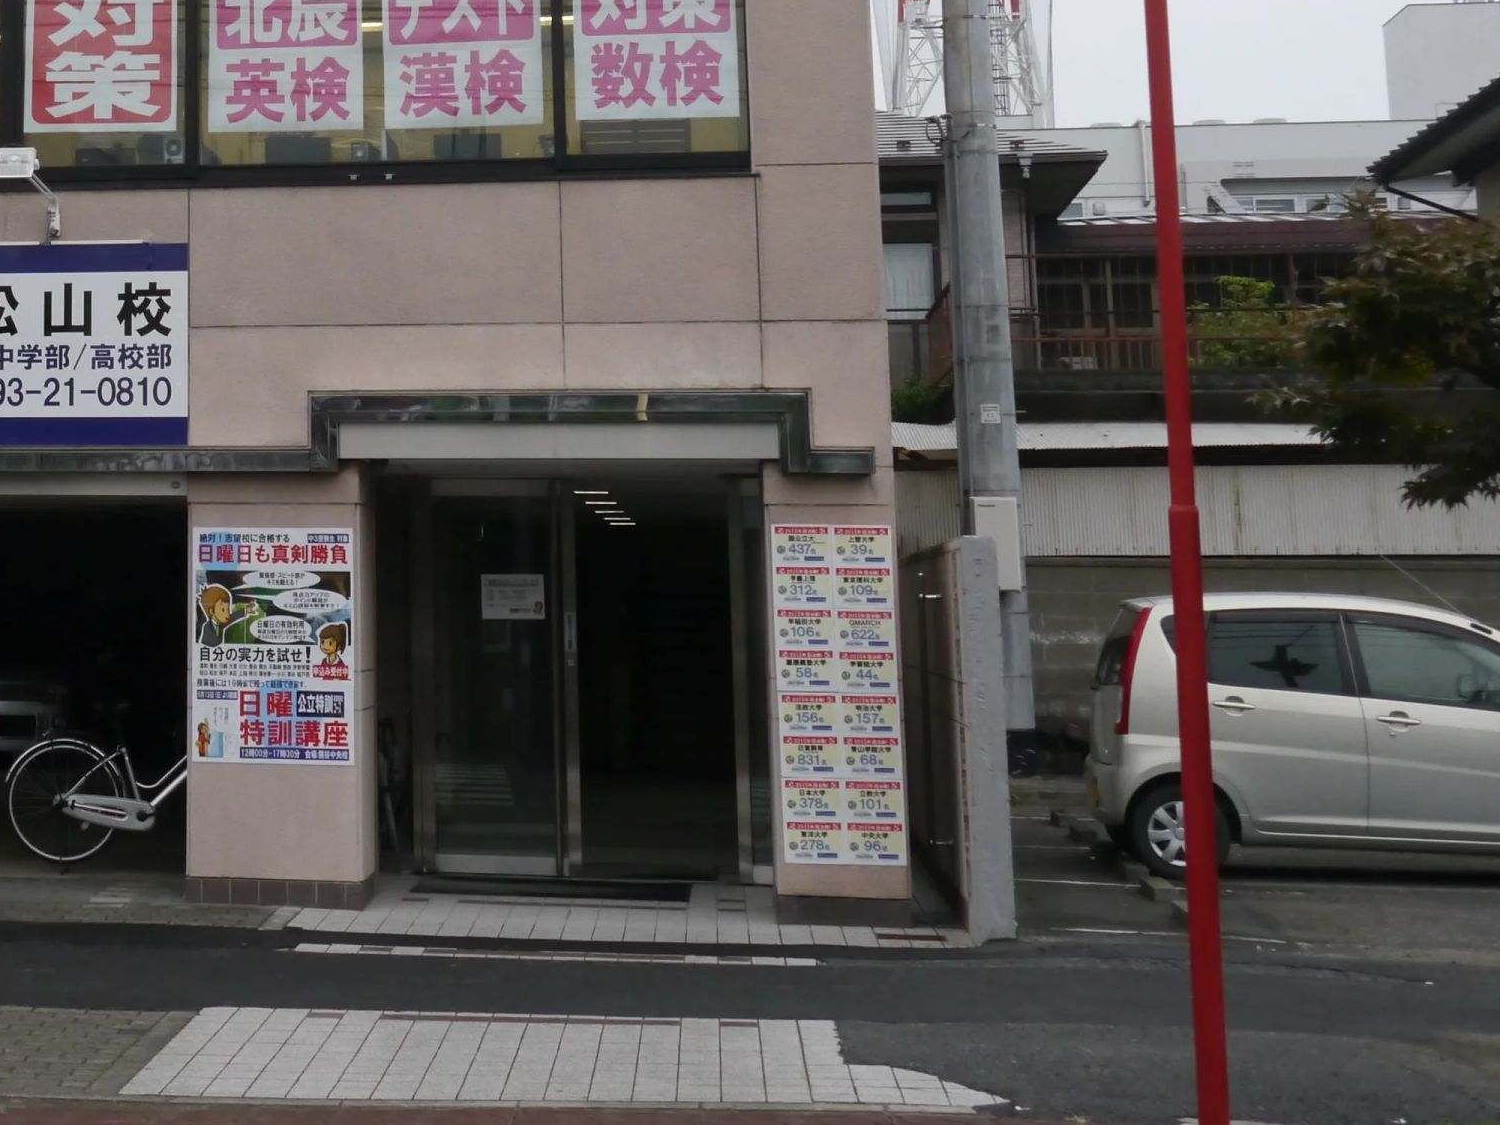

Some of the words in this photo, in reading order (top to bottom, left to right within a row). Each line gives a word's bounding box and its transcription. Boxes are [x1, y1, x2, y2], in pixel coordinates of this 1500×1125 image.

[225, 56, 351, 123] 英検
[400, 50, 527, 118] 漢検
[591, 40, 724, 109] 数検
[199, 545, 348, 564] 日曜日も真剣勝負
[200, 646, 311, 663] 自分の実力を試せ！
[240, 691, 293, 717] 日曜
[240, 719, 348, 747] 特訓講座
